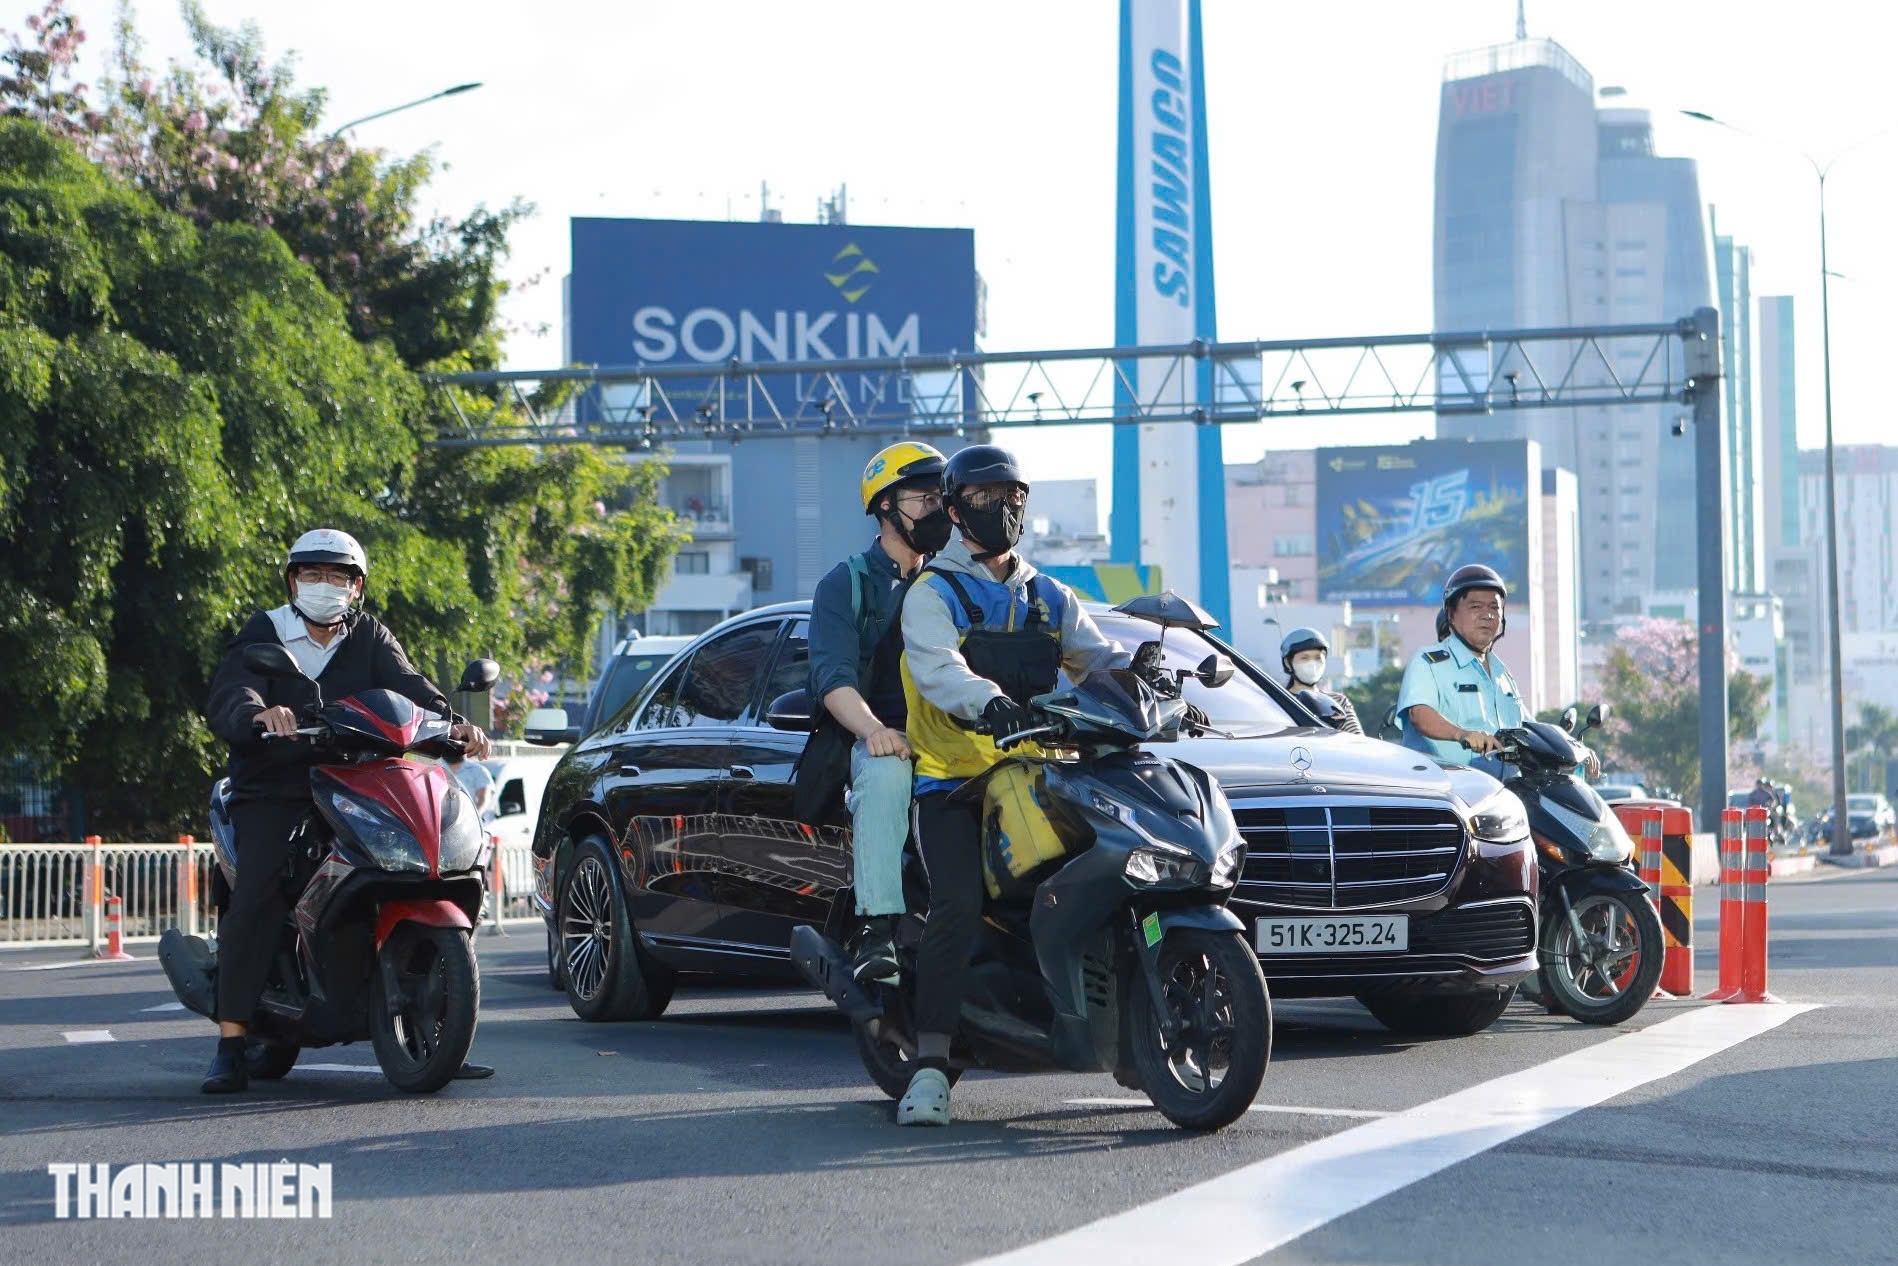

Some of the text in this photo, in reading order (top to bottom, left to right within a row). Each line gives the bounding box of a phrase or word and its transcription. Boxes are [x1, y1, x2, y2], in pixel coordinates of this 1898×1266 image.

[1151, 48, 1190, 308] SAWACO
[633, 306, 920, 362] SONKIM
[1270, 922, 1396, 947] 51K-325.24
